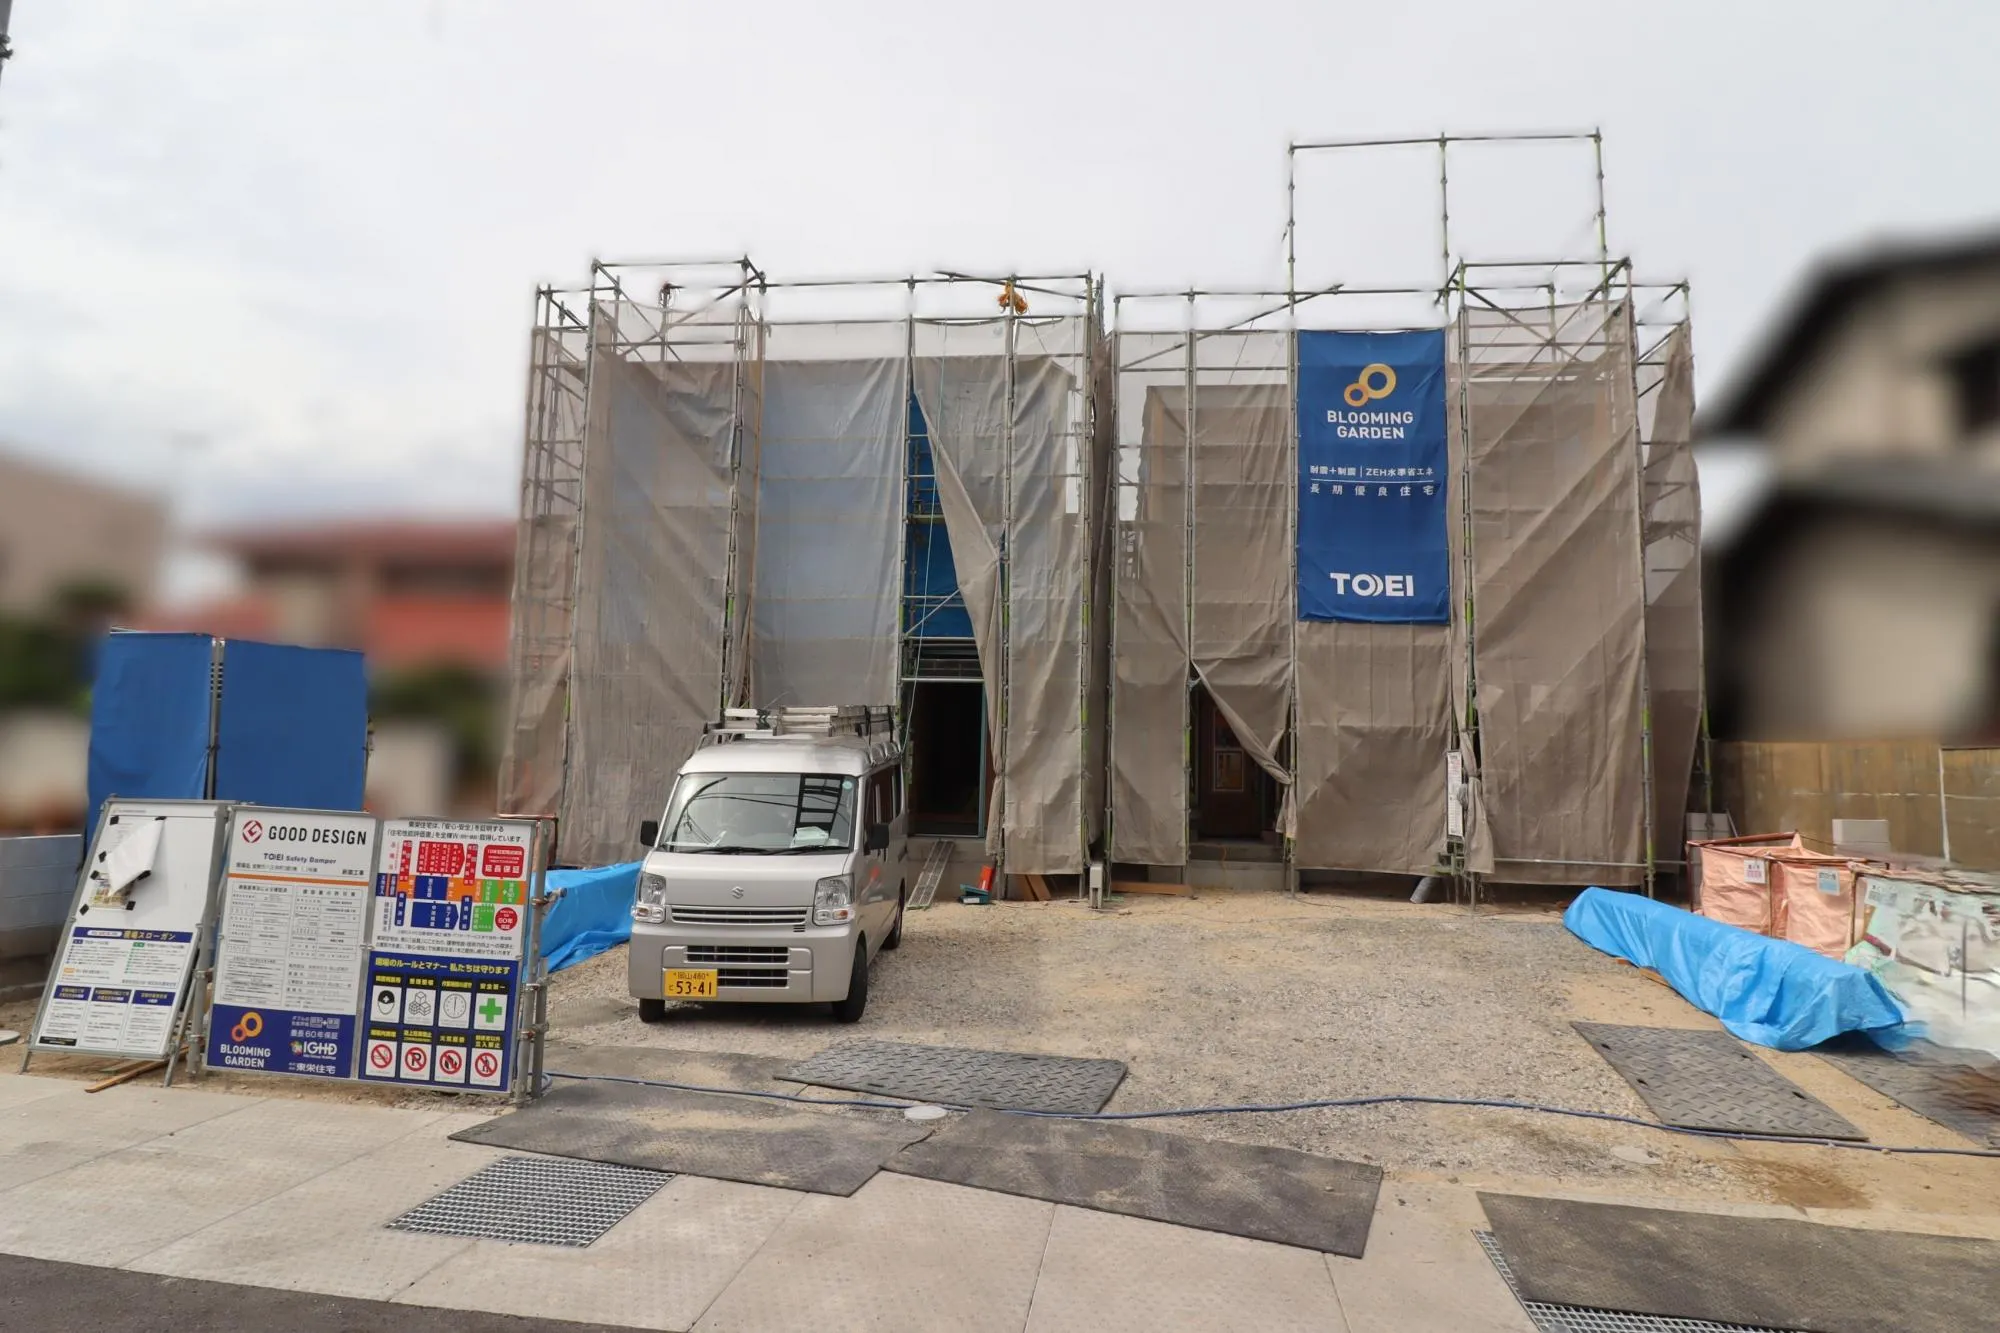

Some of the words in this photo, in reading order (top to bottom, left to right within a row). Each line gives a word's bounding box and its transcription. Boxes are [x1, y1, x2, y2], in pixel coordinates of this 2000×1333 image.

[1327, 410, 1413, 424] BLOOMING
[1337, 426, 1405, 439] GARDEN
[1310, 483, 1434, 497] 長期優良住宅
[268, 826, 308, 844] GOOD
[312, 827, 367, 846] DESIGN
[263, 852, 284, 861] TOEI
[286, 855, 307, 864] Safety
[309, 857, 337, 865] Damper
[375, 957, 448, 970] 現場のルールとマナー
[450, 963, 511, 975] 私たちは守ります
[676, 981, 712, 995] 53-41
[220, 1044, 272, 1058] BLOOMING
[303, 1041, 338, 1055] IGHD
[225, 1055, 265, 1068] GARDEN
[296, 1063, 336, 1074] 東栄住宅
